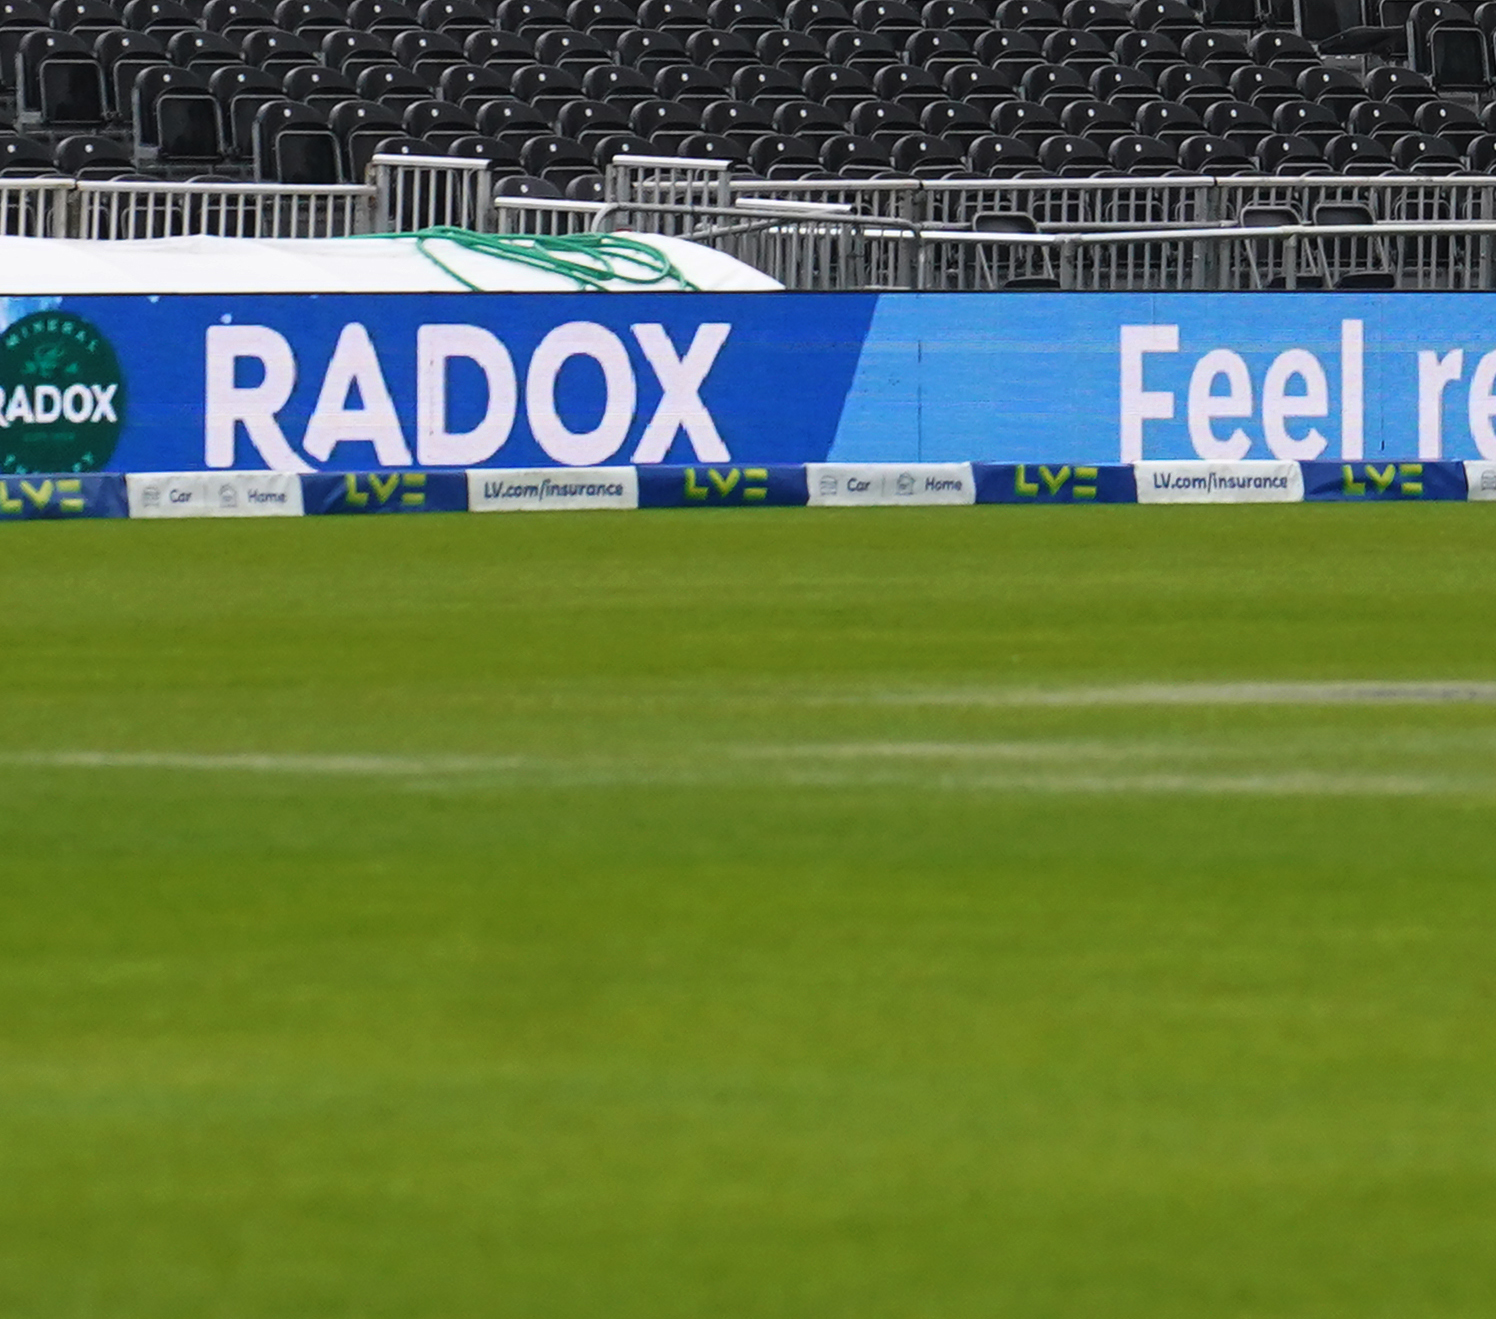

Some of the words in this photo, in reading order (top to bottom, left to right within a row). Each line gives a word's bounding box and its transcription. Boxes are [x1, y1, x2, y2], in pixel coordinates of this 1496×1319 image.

[205, 321, 731, 472] RADOX
[1120, 319, 1363, 462] Feel
[484, 479, 623, 501] LV.com/insurance
[848, 478, 869, 492] Car
[925, 477, 962, 491] Home
[1153, 472, 1288, 492] LV.com/insurance
[170, 490, 191, 504] Car
[248, 488, 287, 504] Home
